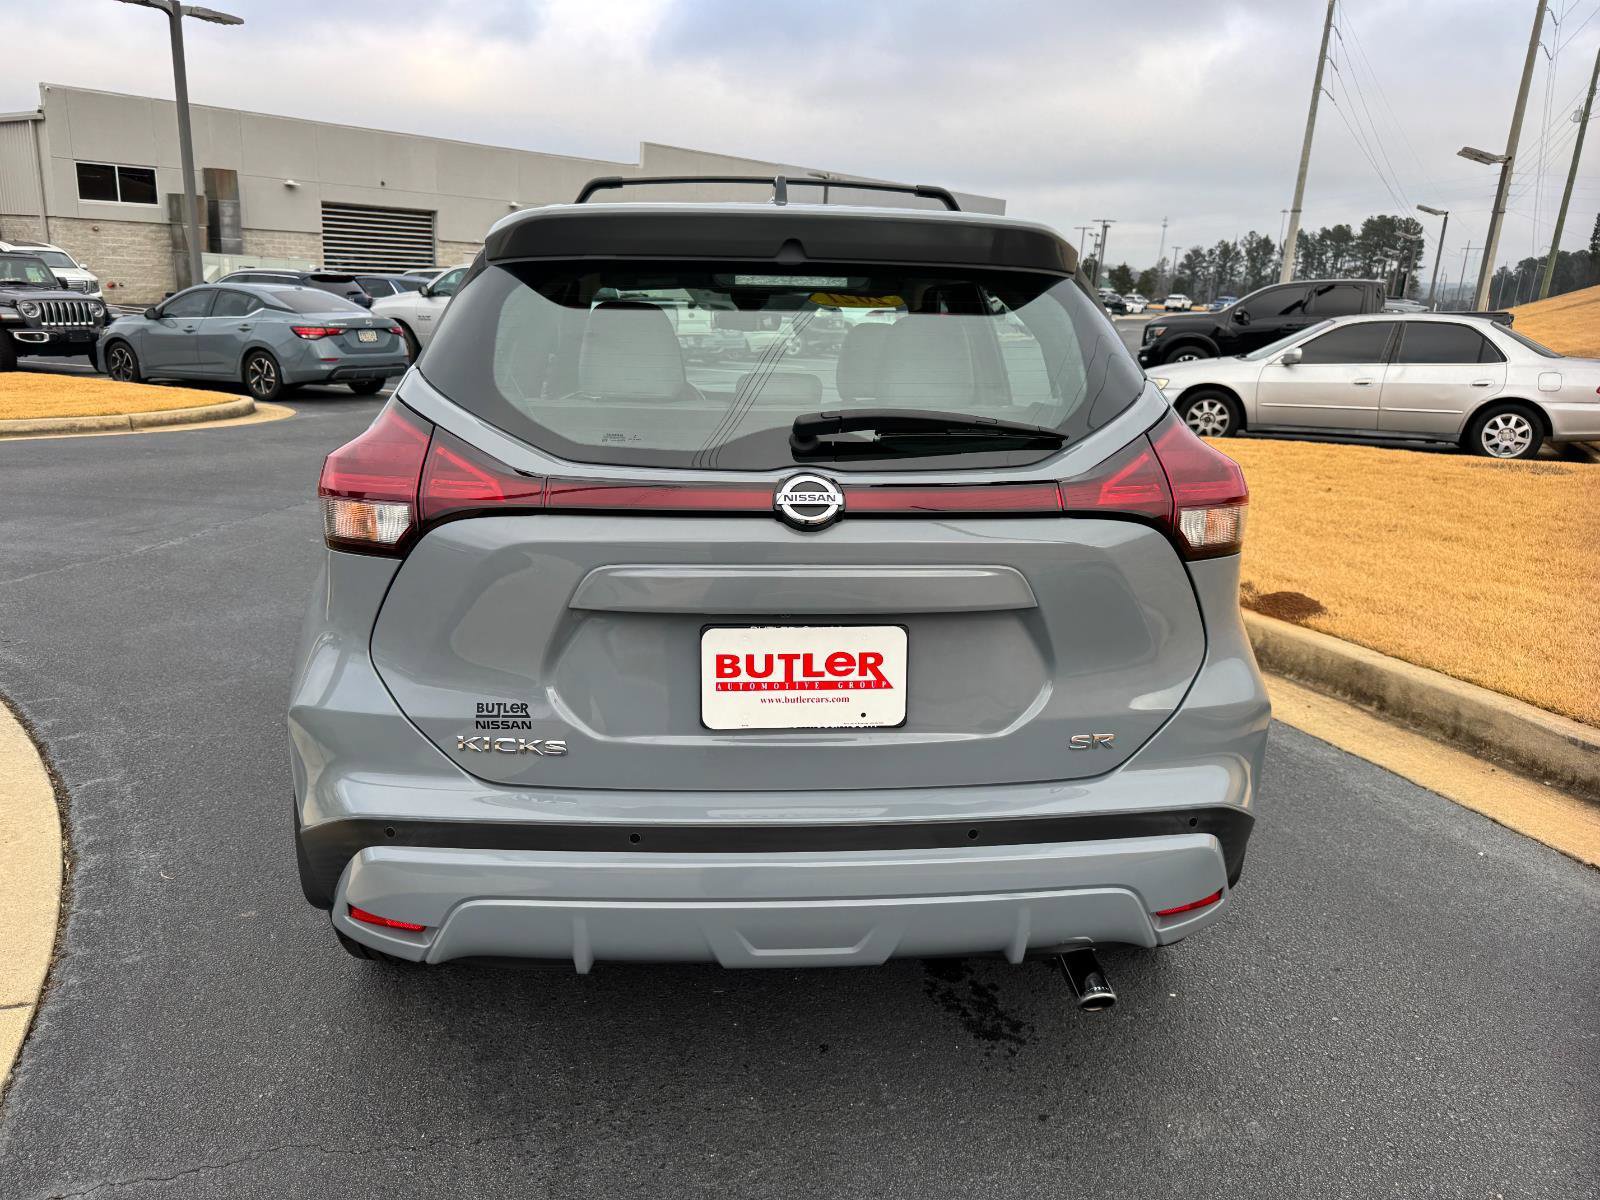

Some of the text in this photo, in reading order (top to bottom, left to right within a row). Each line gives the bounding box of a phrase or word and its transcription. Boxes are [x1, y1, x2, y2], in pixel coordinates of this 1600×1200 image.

[783, 494, 836, 502] NISSAN
[717, 681, 887, 691] AUTOMOTIVE GROUP
[760, 695, 850, 704] www.butlercars.com
[475, 720, 532, 730] NISSAN
[457, 735, 568, 756] KICKS
[1069, 733, 1114, 750] SR
